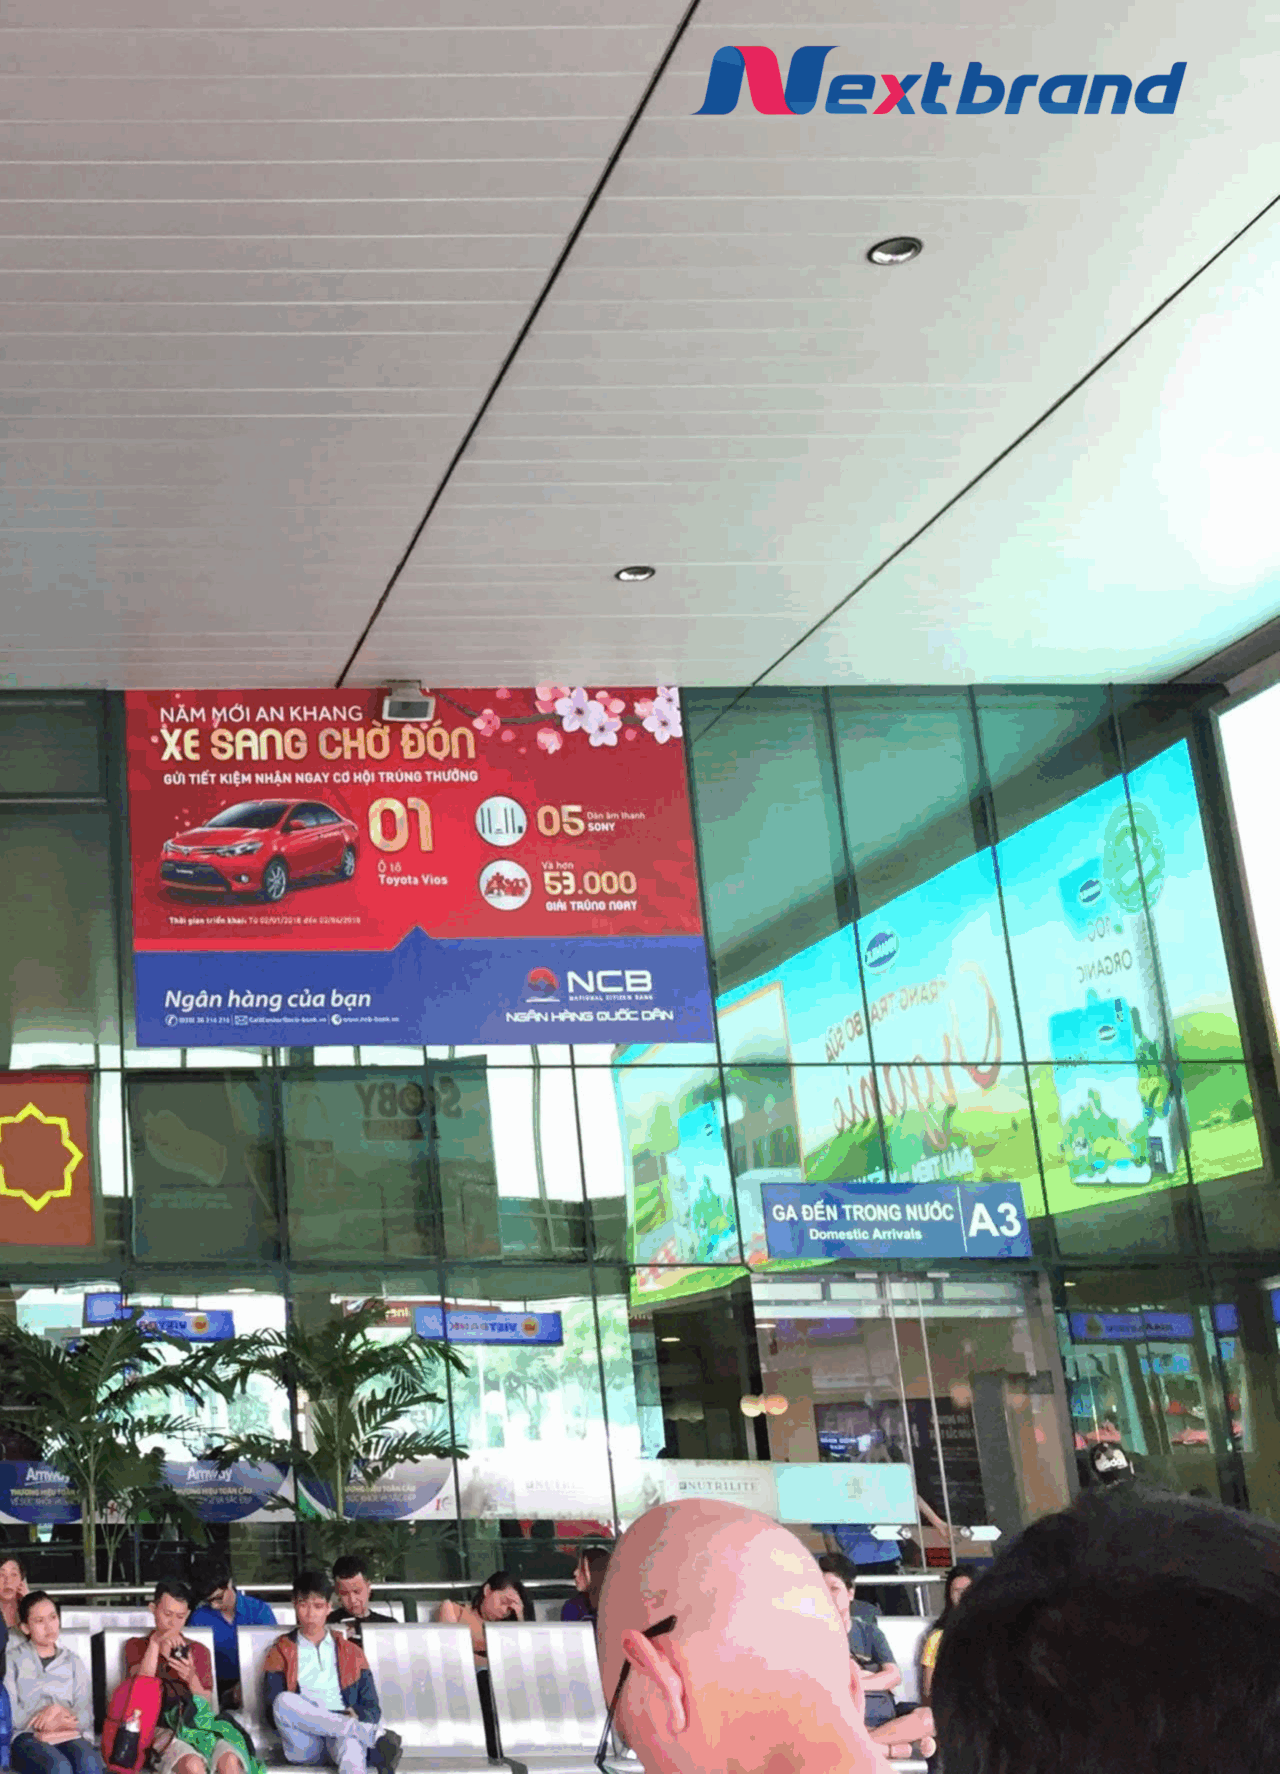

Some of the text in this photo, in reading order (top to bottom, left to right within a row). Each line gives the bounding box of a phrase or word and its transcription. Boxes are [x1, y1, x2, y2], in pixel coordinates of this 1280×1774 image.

[160, 702, 364, 722] NĂM MỚI AN KHANG
[160, 727, 201, 761] XE
[210, 727, 308, 761] SANG
[163, 770, 185, 785] GỬI
[189, 769, 218, 785] TIẾT
[220, 771, 251, 786] KIỆM
[255, 771, 292, 786] NHẬN
[295, 772, 329, 784] NGAY
[353, 771, 375, 785] HỘI
[379, 769, 422, 783] TRÚNG
[368, 797, 434, 852] 01
[536, 805, 585, 836] 05
[587, 822, 615, 832] SONY
[378, 873, 448, 887] Toyota Vios
[543, 870, 637, 896] 53.000
[567, 970, 652, 993] NCB
[164, 988, 371, 1012] Ngân hàng của bạn
[506, 1008, 674, 1022] NGÂN HÀNG QUỐC DÂN
[772, 1199, 954, 1221] GA ĐẾN TRONG NƯỚC
[969, 1202, 1022, 1237] A3
[809, 1227, 923, 1241] Domestic Arrivals
[687, 1480, 758, 1491] NUTRILITE
